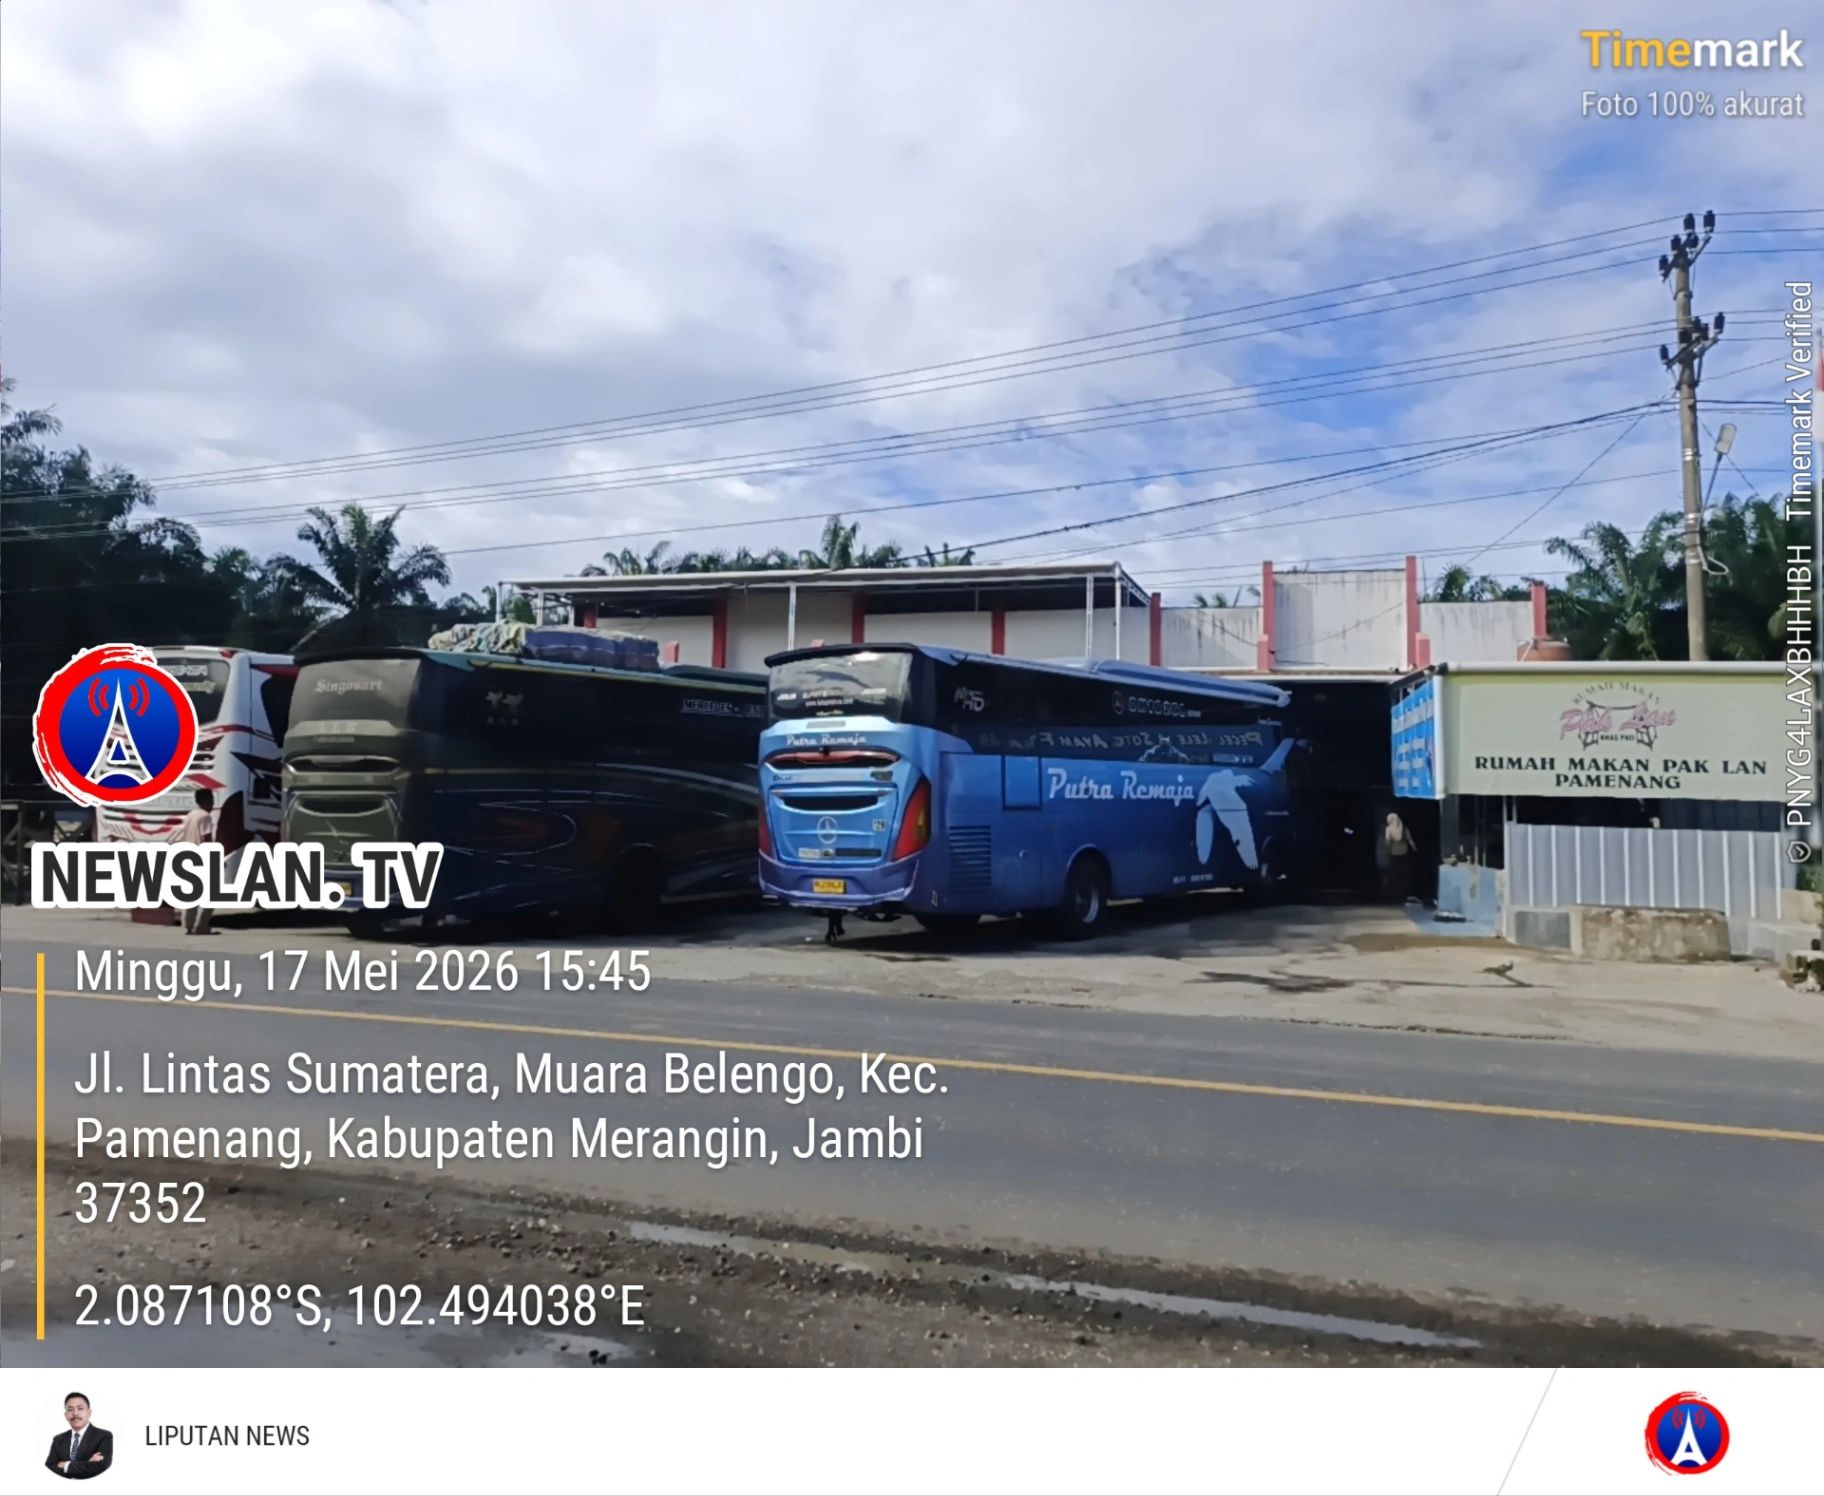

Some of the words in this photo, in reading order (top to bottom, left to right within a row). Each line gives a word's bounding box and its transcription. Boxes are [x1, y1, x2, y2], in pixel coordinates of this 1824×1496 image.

[1560, 706, 1613, 739] Pak
[785, 733, 818, 746] Putra
[820, 733, 867, 746] Remaja
[1475, 756, 1556, 770] RUMAH
[1568, 757, 1650, 773] MAKAN
[1663, 759, 1710, 774] PAK
[1722, 760, 1767, 775] LAN
[1047, 767, 1115, 800] Putra
[1120, 770, 1196, 808] Remaja
[1555, 773, 1681, 789] PAMENANG
